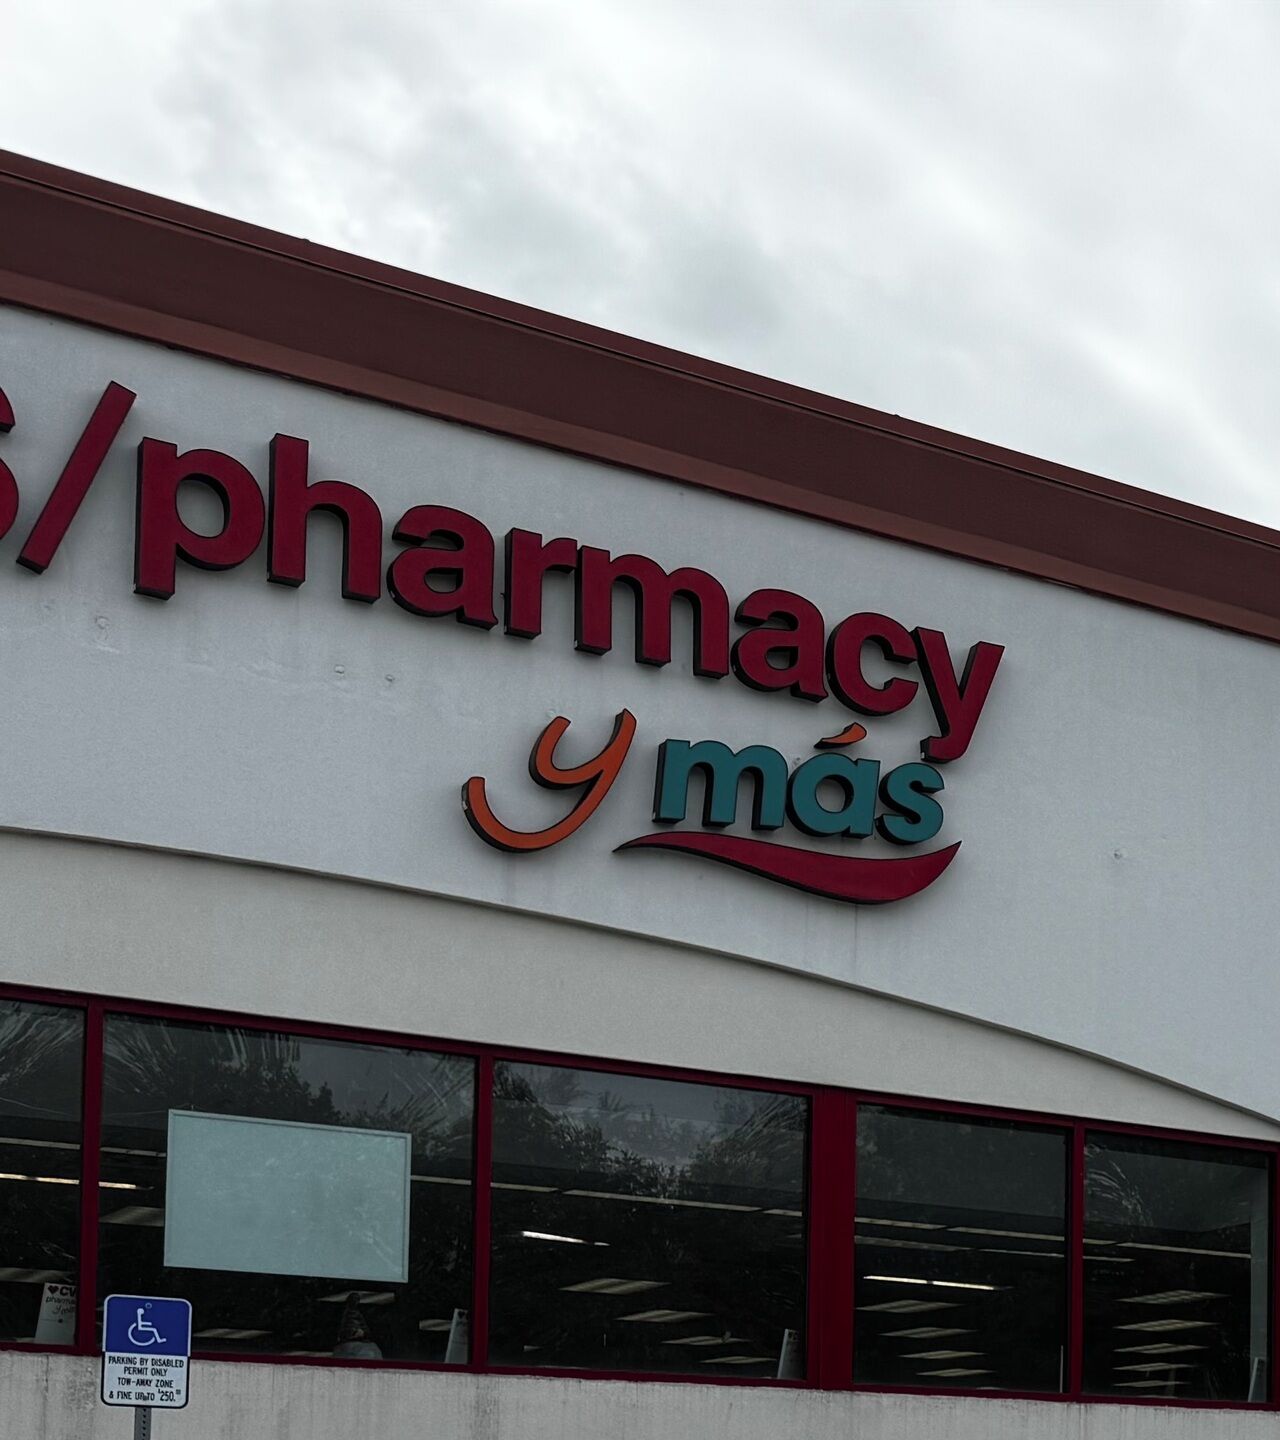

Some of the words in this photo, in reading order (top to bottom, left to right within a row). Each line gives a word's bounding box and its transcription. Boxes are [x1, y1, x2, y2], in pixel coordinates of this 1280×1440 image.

[0, 381, 1003, 764] /pharmacy
[460, 709, 636, 853] y
[652, 722, 946, 846] más
[108, 1356, 137, 1366] PARKING
[140, 1358, 149, 1366] BY
[151, 1358, 184, 1368] DISABLED
[124, 1367, 148, 1376] PERMIT
[151, 1368, 168, 1376] ONLY
[118, 1377, 153, 1387] TOW-AWAY
[156, 1380, 174, 1388] ZONE
[117, 1391, 132, 1399] FINE
